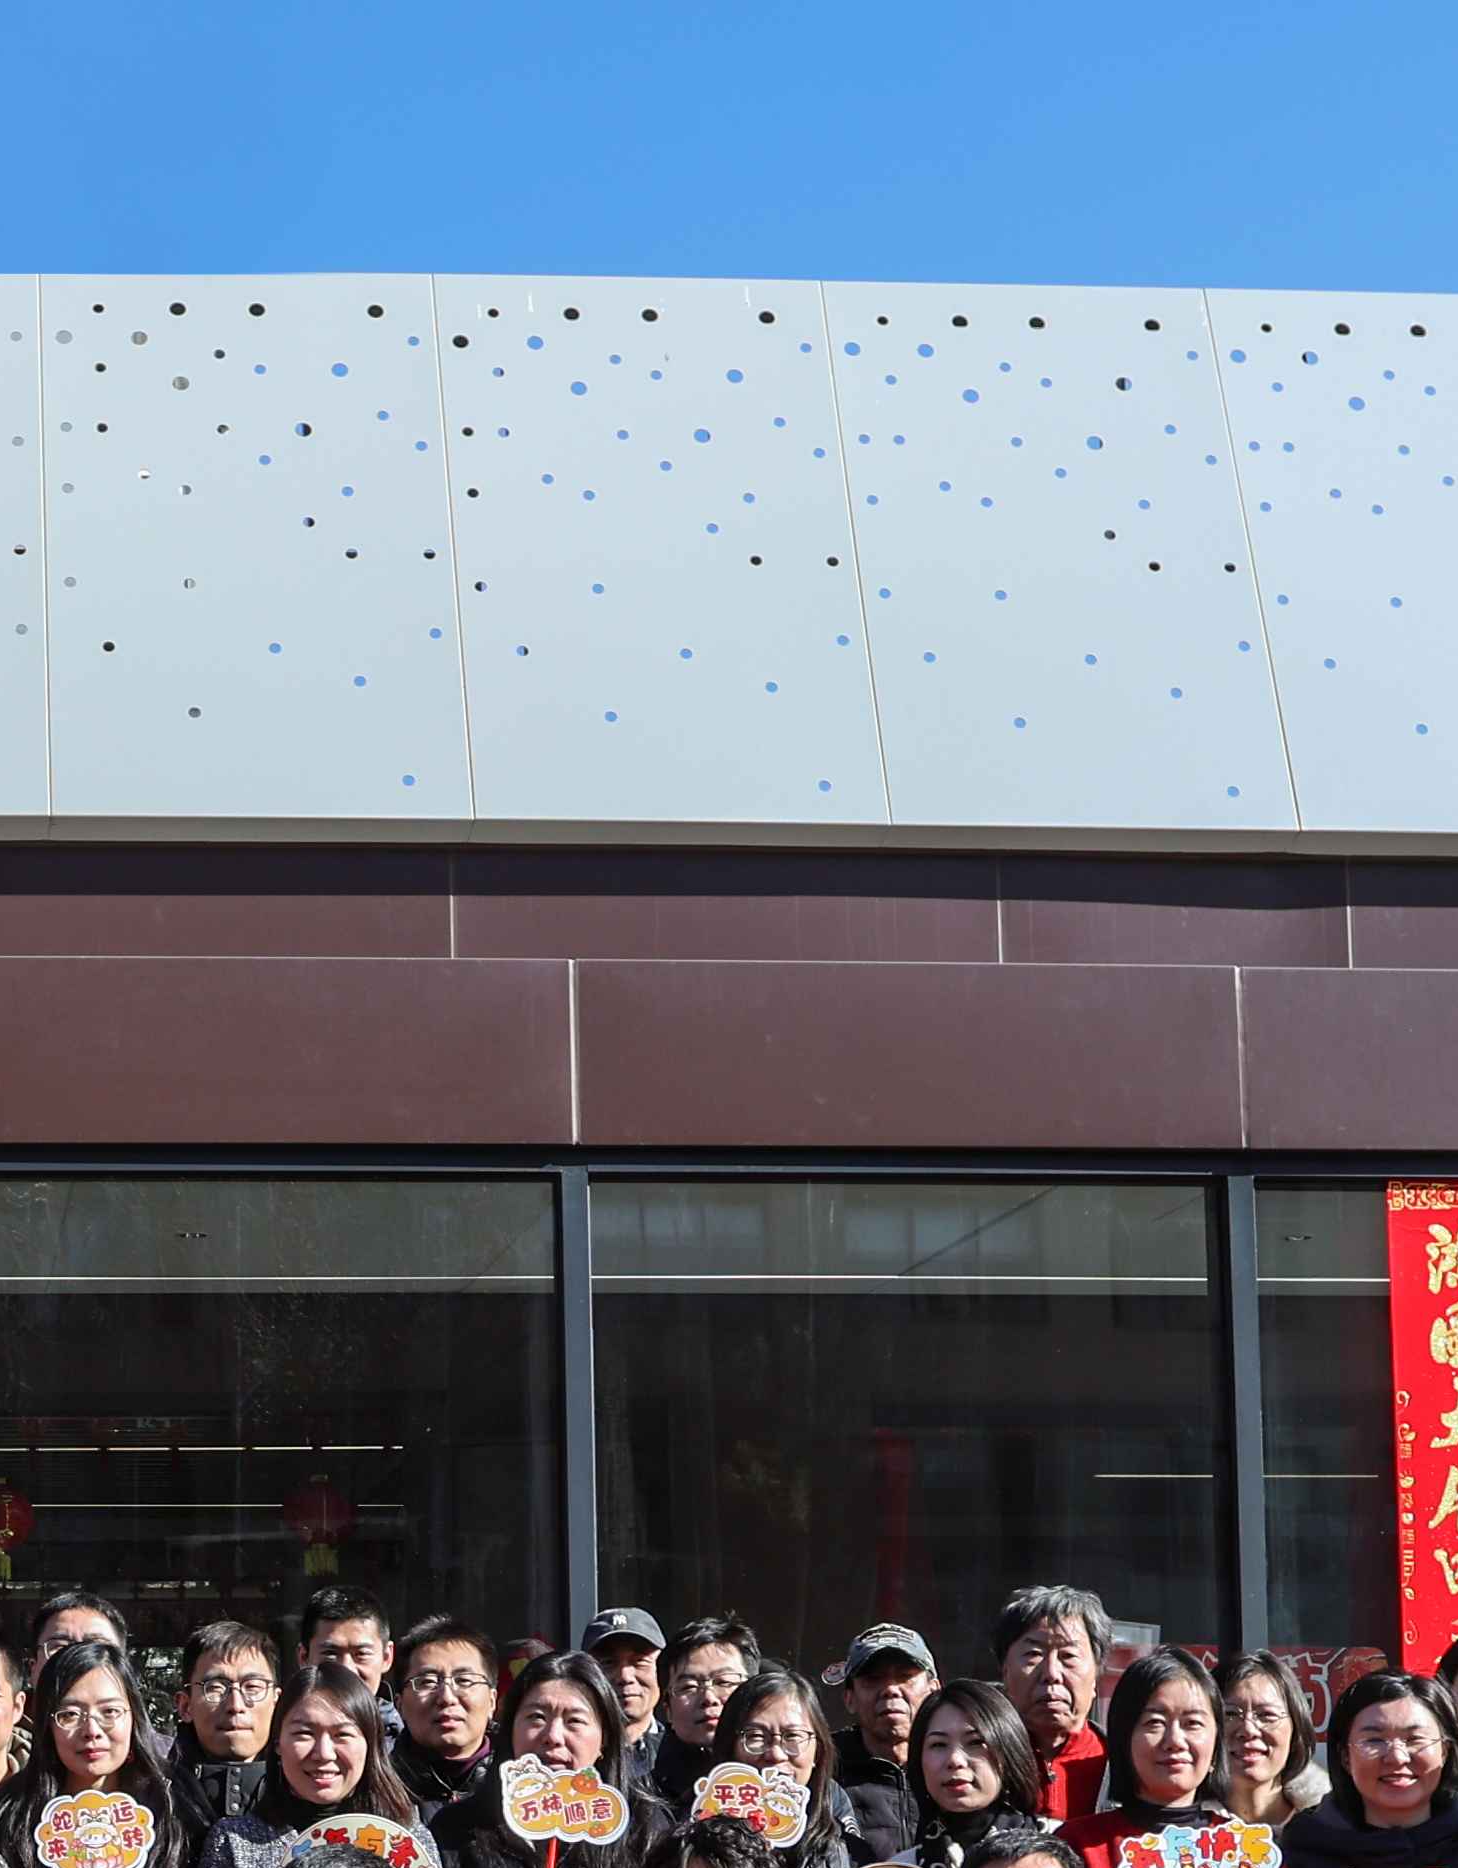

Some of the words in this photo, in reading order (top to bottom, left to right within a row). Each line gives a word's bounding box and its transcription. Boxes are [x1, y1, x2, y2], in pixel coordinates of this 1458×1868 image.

[713, 1784, 761, 1806] 平安
[520, 1793, 612, 1825] 万柿顺意
